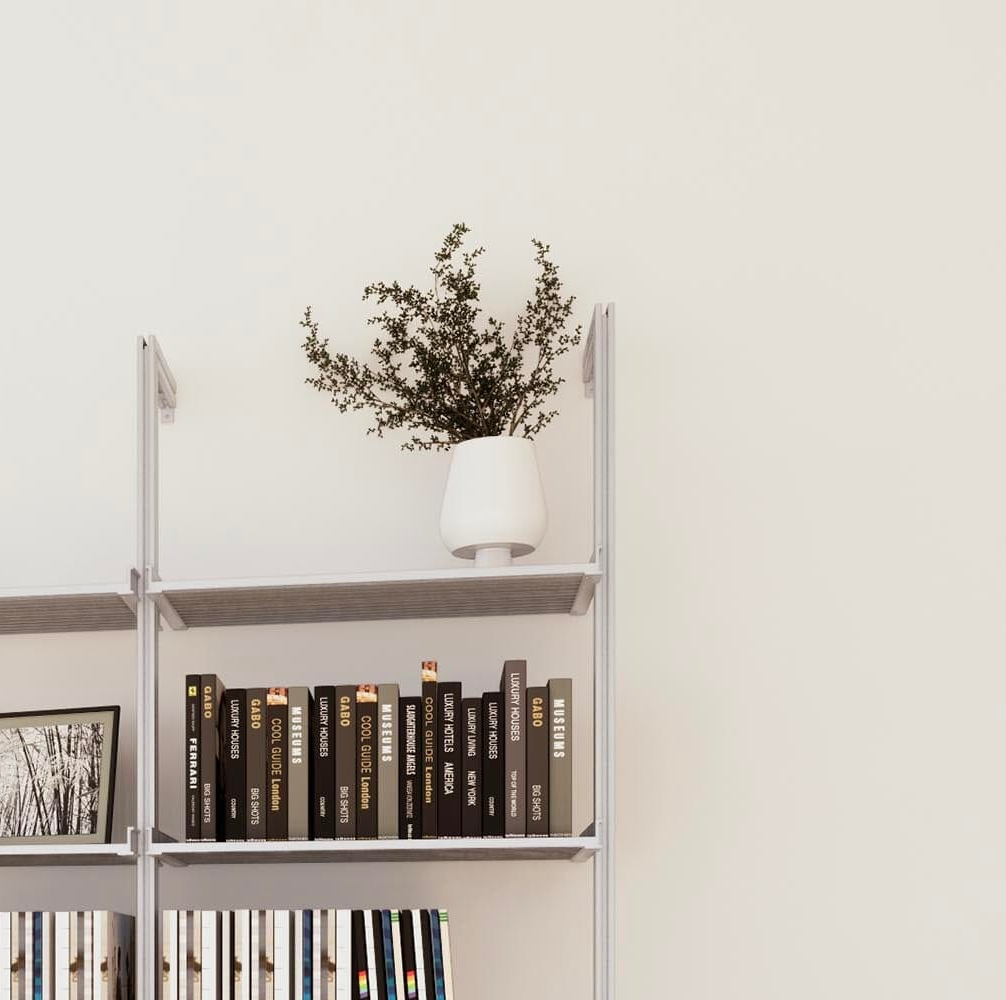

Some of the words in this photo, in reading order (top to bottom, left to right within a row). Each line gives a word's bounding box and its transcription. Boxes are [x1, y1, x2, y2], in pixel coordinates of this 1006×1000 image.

[204, 686, 212, 718] GABO
[510, 672, 520, 705] LUXURY
[230, 699, 239, 728] LUXURY
[251, 698, 261, 729] GABO
[320, 697, 328, 726] LUXURY
[340, 696, 350, 726] GABO
[425, 697, 433, 726] COOL
[444, 693, 453, 722] LUXURY
[467, 708, 476, 734] LUXURY
[489, 702, 497, 729] LUXURY
[533, 697, 542, 727] GABO
[272, 718, 282, 744] COOL
[292, 706, 302, 764] MUSEUMS
[361, 715, 371, 742] COOL
[382, 704, 392, 762] MUSEUMS
[444, 724, 453, 752] HOTELS
[510, 707, 520, 742] HOUSES
[554, 699, 564, 758] MUSEUMS
[230, 729, 239, 759] HOUSES
[320, 727, 328, 757] HOUSES
[425, 730, 433, 763] GUIDE
[467, 735, 476, 756] LIVING
[489, 730, 497, 759] HOUSES
[190, 738, 198, 789] FERRARI
[272, 747, 282, 775] GUIDE
[361, 744, 371, 773] GUIDE
[406, 754, 415, 775] ANGELS
[340, 786, 348, 798] BIG
[361, 776, 371, 809] London
[444, 762, 453, 795] AMERICA
[468, 770, 476, 786] NEW
[532, 784, 541, 797] BIG
[251, 788, 259, 800] BIG
[272, 778, 281, 810] London
[468, 787, 476, 806] YORK
[251, 801, 259, 825] SHOTS
[340, 799, 348, 823] SHOTS
[532, 798, 541, 820] SHOTS
